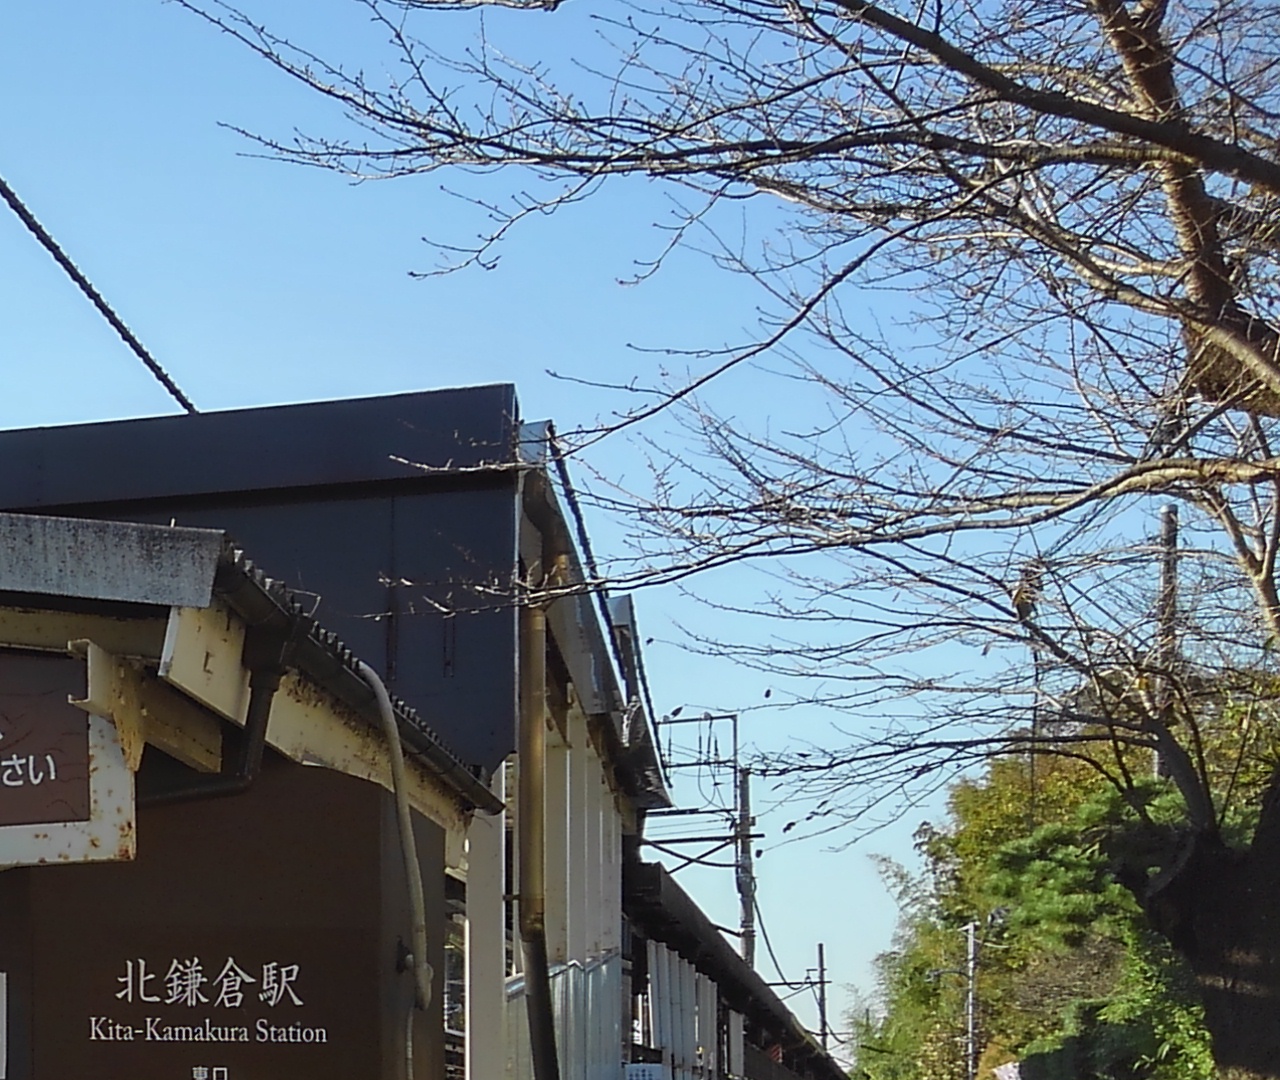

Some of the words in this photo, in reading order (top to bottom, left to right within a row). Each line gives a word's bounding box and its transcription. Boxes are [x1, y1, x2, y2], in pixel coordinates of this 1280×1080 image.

[115, 956, 304, 1008] 北鎌倉駅
[89, 1016, 249, 1043] Kita-Kamakura
[256, 1018, 328, 1043] Station
